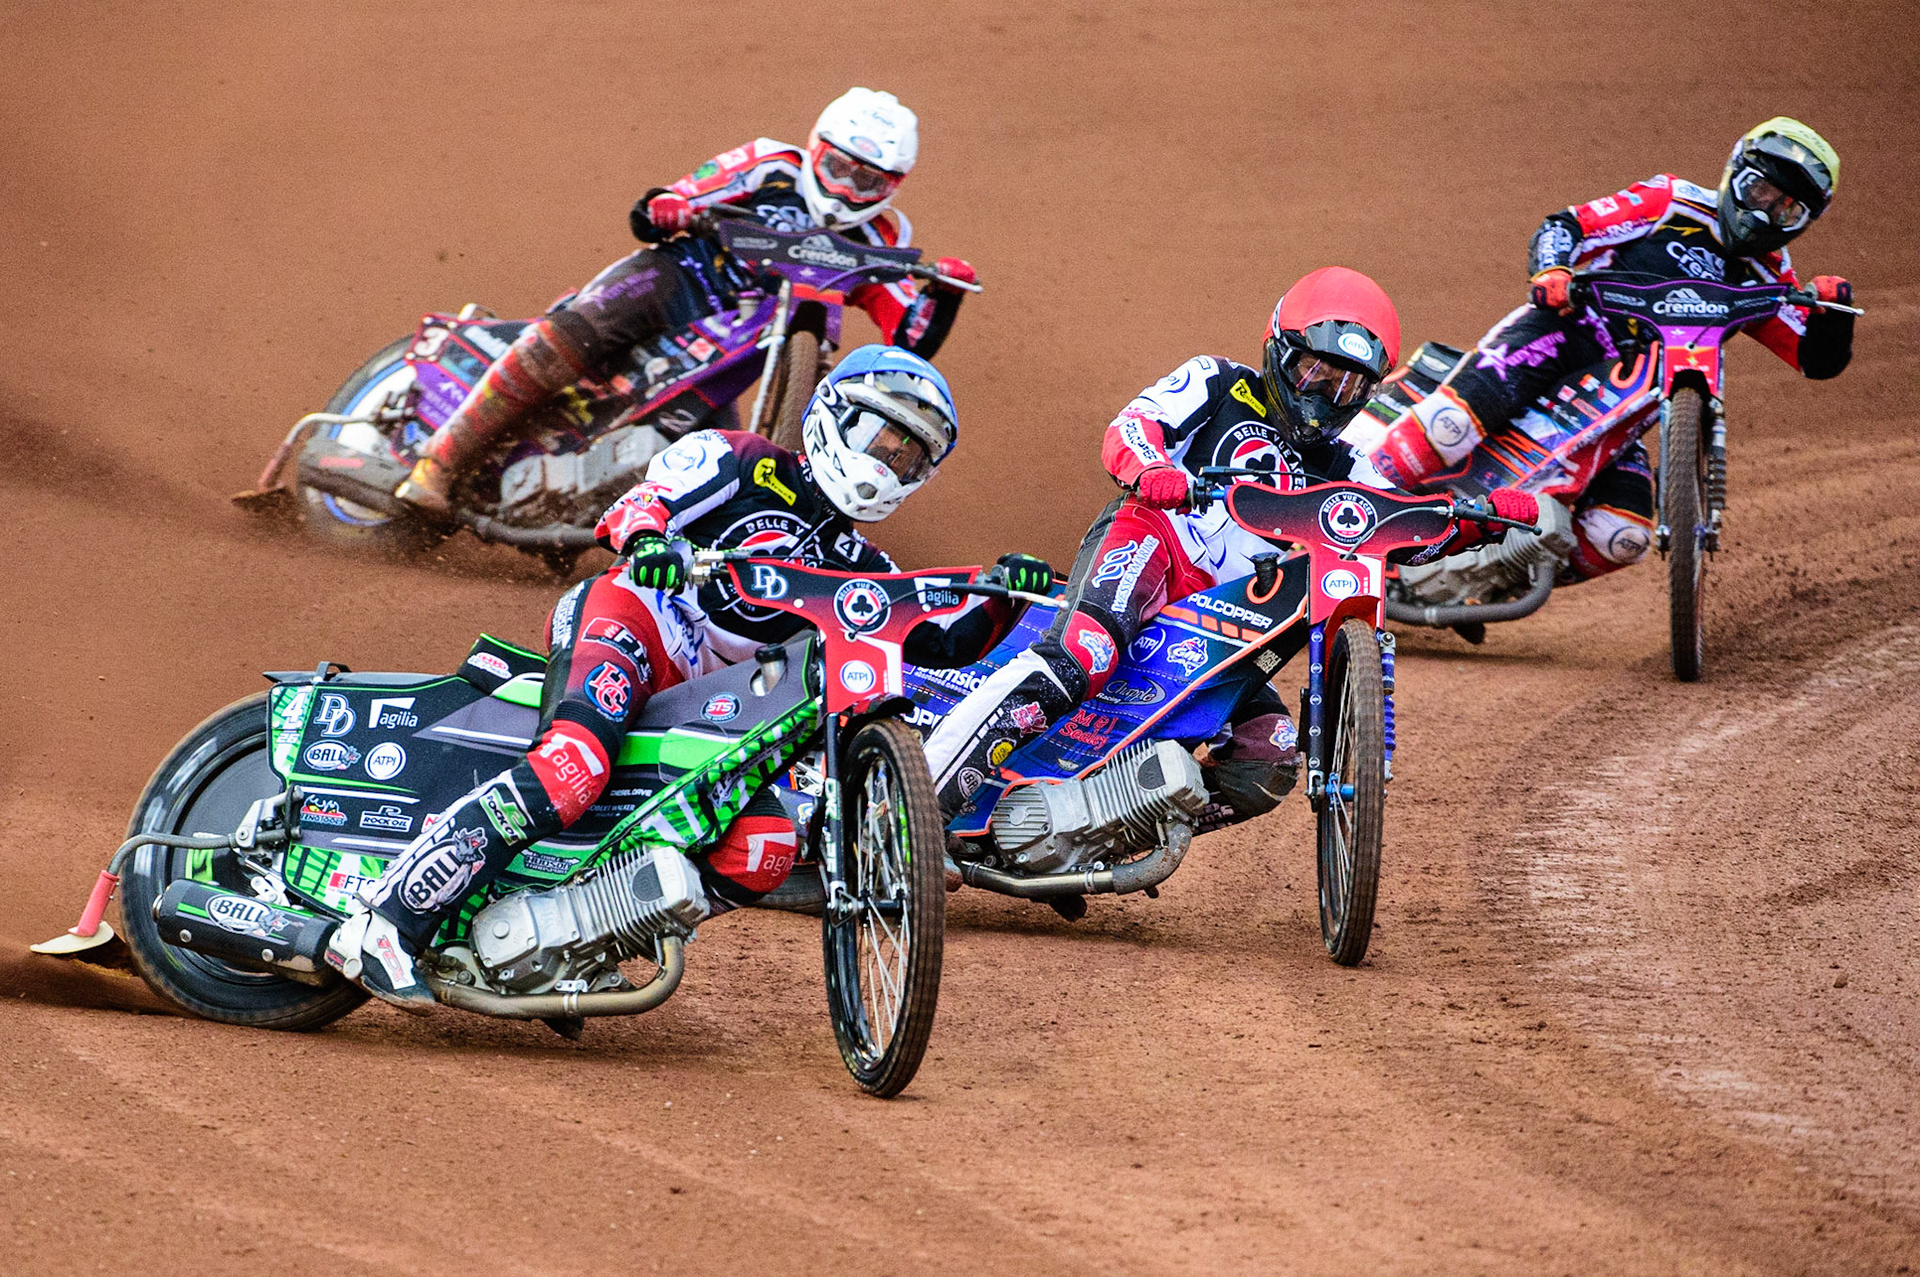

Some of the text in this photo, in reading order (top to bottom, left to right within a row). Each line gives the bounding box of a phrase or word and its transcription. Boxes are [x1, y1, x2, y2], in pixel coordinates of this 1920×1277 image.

[787, 245, 858, 267] Crendon
[1652, 300, 1729, 314] Crendon
[414, 327, 449, 356] 3
[1233, 426, 1268, 441] BELLE
[1273, 434, 1291, 458] VUE
[1323, 496, 1341, 513] BELLE
[1359, 500, 1373, 516] ACES
[745, 519, 789, 533] BELLE
[750, 564, 790, 599] DD
[1329, 579, 1353, 589] ATPI
[872, 586, 886, 603] ACES
[927, 590, 959, 606] agilia
[1187, 593, 1273, 629] POLCOPPER
[1134, 635, 1159, 650] ATPI
[847, 671, 868, 681] ATPI
[917, 666, 988, 692] urnsid
[281, 691, 306, 723] 4
[1095, 692, 1121, 704] Racing
[314, 693, 356, 737] DD
[379, 711, 419, 729] agilia
[1071, 709, 1097, 727] M
[276, 732, 300, 743] 26
[373, 755, 397, 766] ATPI
[553, 751, 592, 804] agilia
[363, 816, 408, 827] ROCK OIL
[216, 899, 264, 922] BALL
